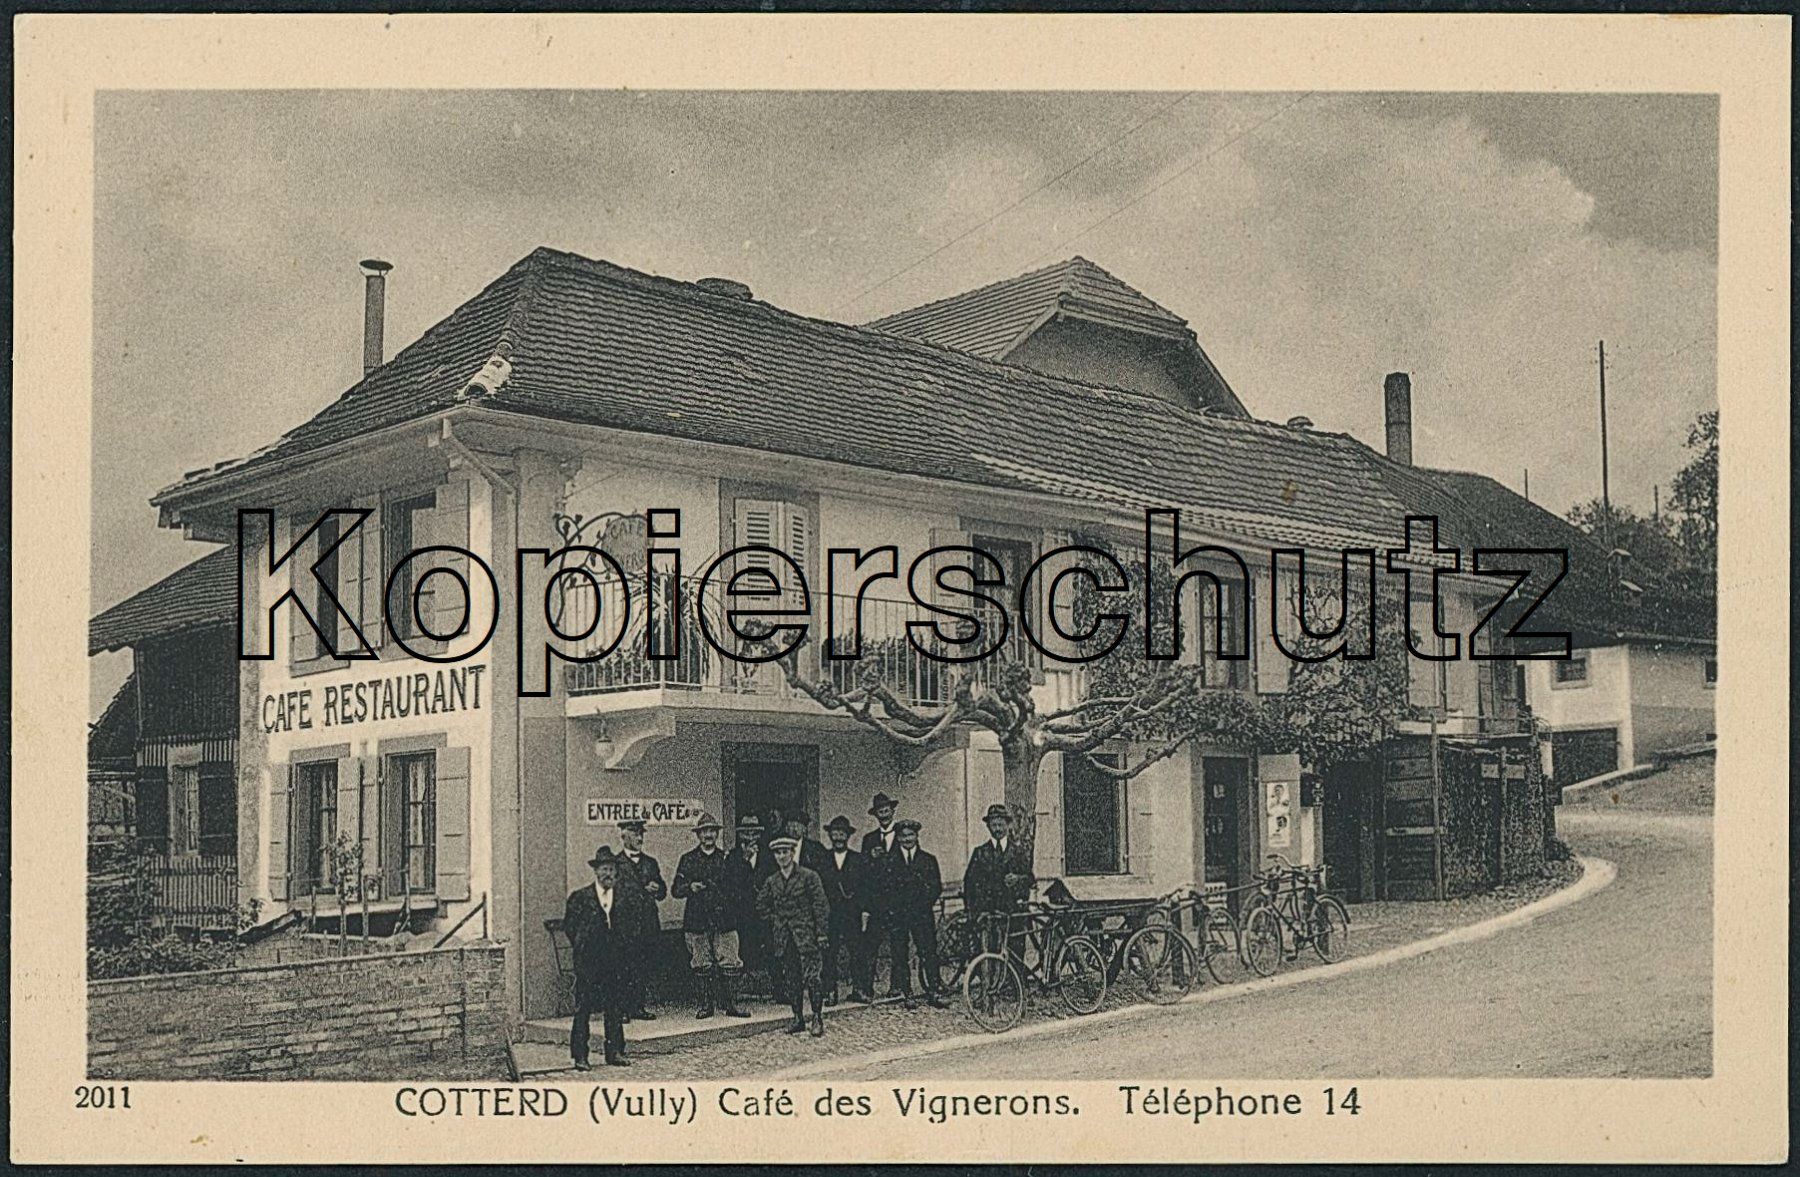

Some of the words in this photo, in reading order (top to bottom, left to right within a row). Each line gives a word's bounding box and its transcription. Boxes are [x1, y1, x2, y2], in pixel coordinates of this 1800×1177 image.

[262, 681, 313, 734] CAFÉ
[323, 664, 487, 727] RESTAURANT
[652, 800, 686, 821] CAFÉ
